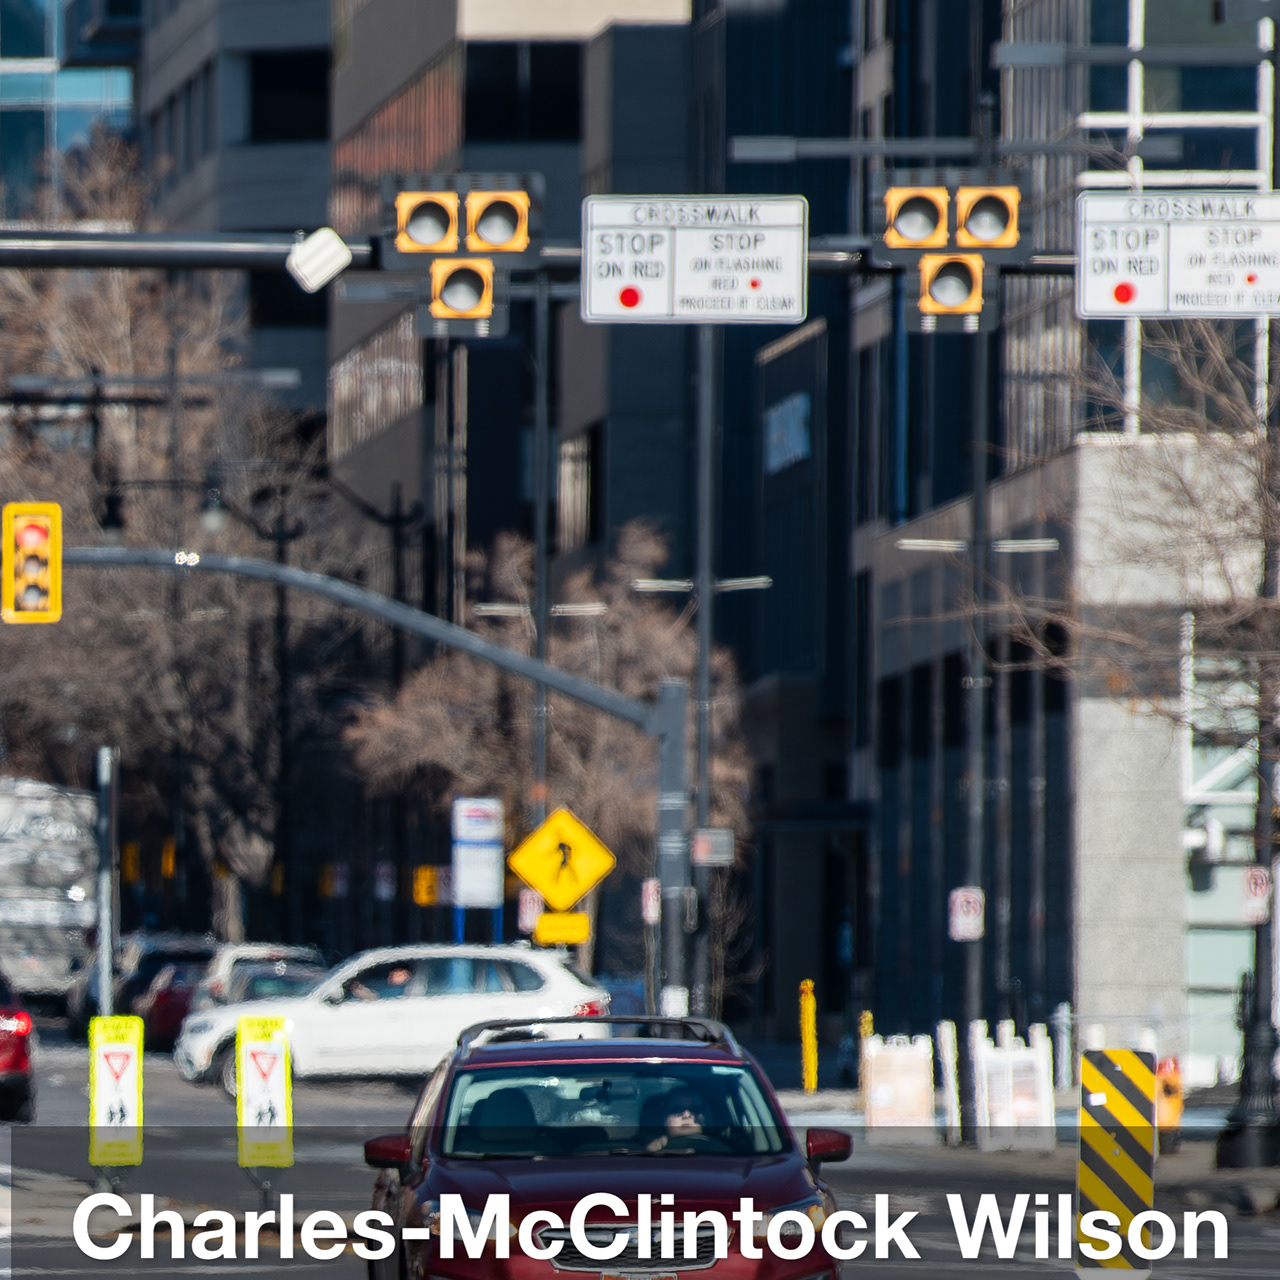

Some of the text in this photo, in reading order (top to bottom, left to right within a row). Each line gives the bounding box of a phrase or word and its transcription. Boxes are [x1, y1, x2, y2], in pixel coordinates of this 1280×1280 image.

[633, 203, 761, 224] CROSSWALK
[1127, 198, 1257, 217] CROSSWALK
[597, 233, 664, 255] STOP
[710, 233, 766, 250] STOP
[1092, 228, 1160, 250] STOP
[1207, 228, 1262, 247] STOP
[597, 260, 664, 278] ON RED
[1092, 257, 1160, 275] ON RED
